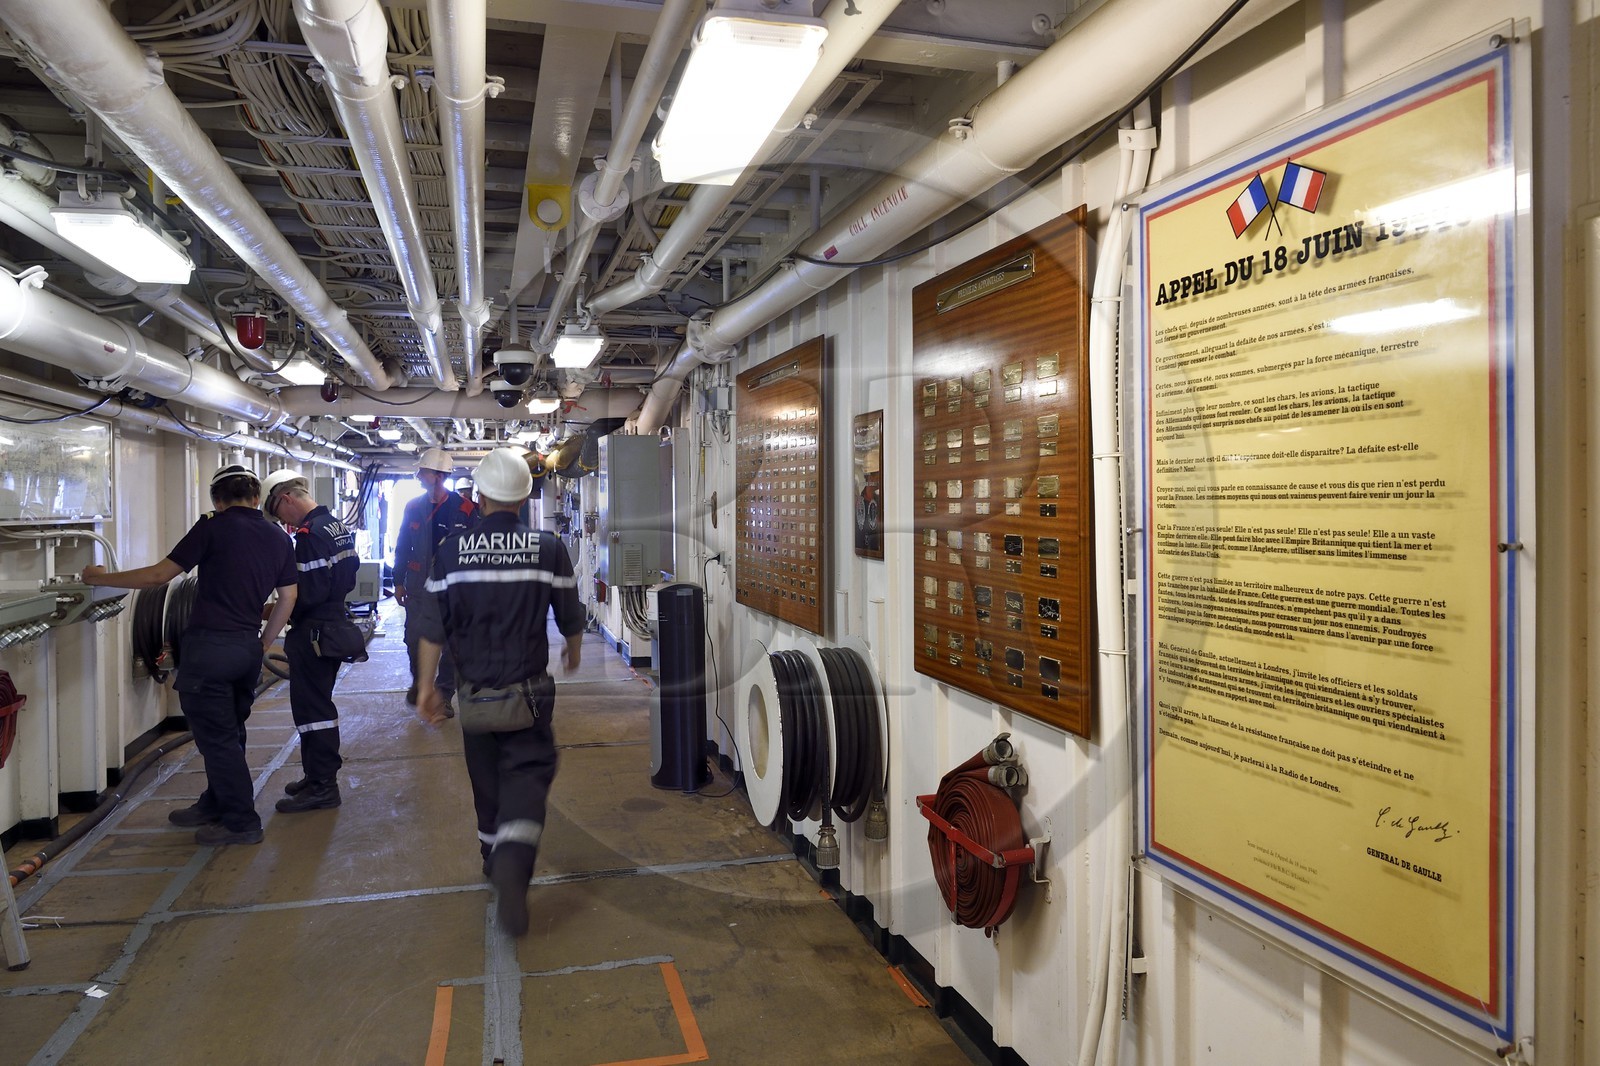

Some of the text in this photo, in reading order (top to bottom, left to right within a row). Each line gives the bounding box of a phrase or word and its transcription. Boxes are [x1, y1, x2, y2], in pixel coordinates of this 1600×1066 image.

[1155, 268, 1218, 306] APPEL
[1224, 255, 1254, 286] DU
[1262, 246, 1288, 274] 18
[1296, 220, 1364, 264] JUIN
[1165, 325, 1178, 334] chefs
[1190, 318, 1207, 328] depuis
[1216, 308, 1250, 322] nombreuses
[1279, 297, 1293, 306] sont
[1324, 287, 1336, 295] des
[1308, 322, 1325, 331] s'est
[1293, 360, 1304, 369] par
[1315, 356, 1333, 364] force
[1381, 341, 1419, 352] terrestre
[1183, 407, 1194, 416] plus
[1347, 383, 1380, 393] tactique
[1272, 450, 1299, 459] doit-elle
[1387, 442, 1419, 452] est-elle
[1197, 485, 1206, 494] qui
[1221, 484, 1236, 493] parle
[1419, 479, 1445, 489] perdu
[458, 532, 540, 551] MARINE
[1373, 530, 1389, 538] Elle
[458, 554, 540, 564] NATIONALE
[1244, 581, 1272, 590] territoire
[1274, 584, 1314, 594] malheureux
[1316, 587, 1324, 595] de
[1347, 592, 1367, 601] pays.
[1368, 592, 1390, 602] Cette
[1393, 597, 1422, 605] guerre
[1423, 598, 1446, 608] n'est
[1159, 700, 1171, 710] Quoi
[1208, 715, 1229, 727] flamme
[1230, 721, 1237, 730] de
[1238, 723, 1244, 732] la
[1279, 735, 1310, 751] française
[1322, 747, 1335, 758] doit
[1337, 754, 1350, 763] pas
[1352, 757, 1391, 774] s'éteindre
[1404, 773, 1414, 781] ne
[1180, 736, 1198, 746] comme
[1234, 752, 1239, 761] je
[1240, 756, 1264, 768] parlerai
[1271, 764, 1278, 773] la
[1279, 766, 1299, 779] Radio
[1300, 773, 1308, 782] de
[1310, 776, 1340, 793] Londres.
[1366, 846, 1442, 882] GENERAL DE GAULLE
